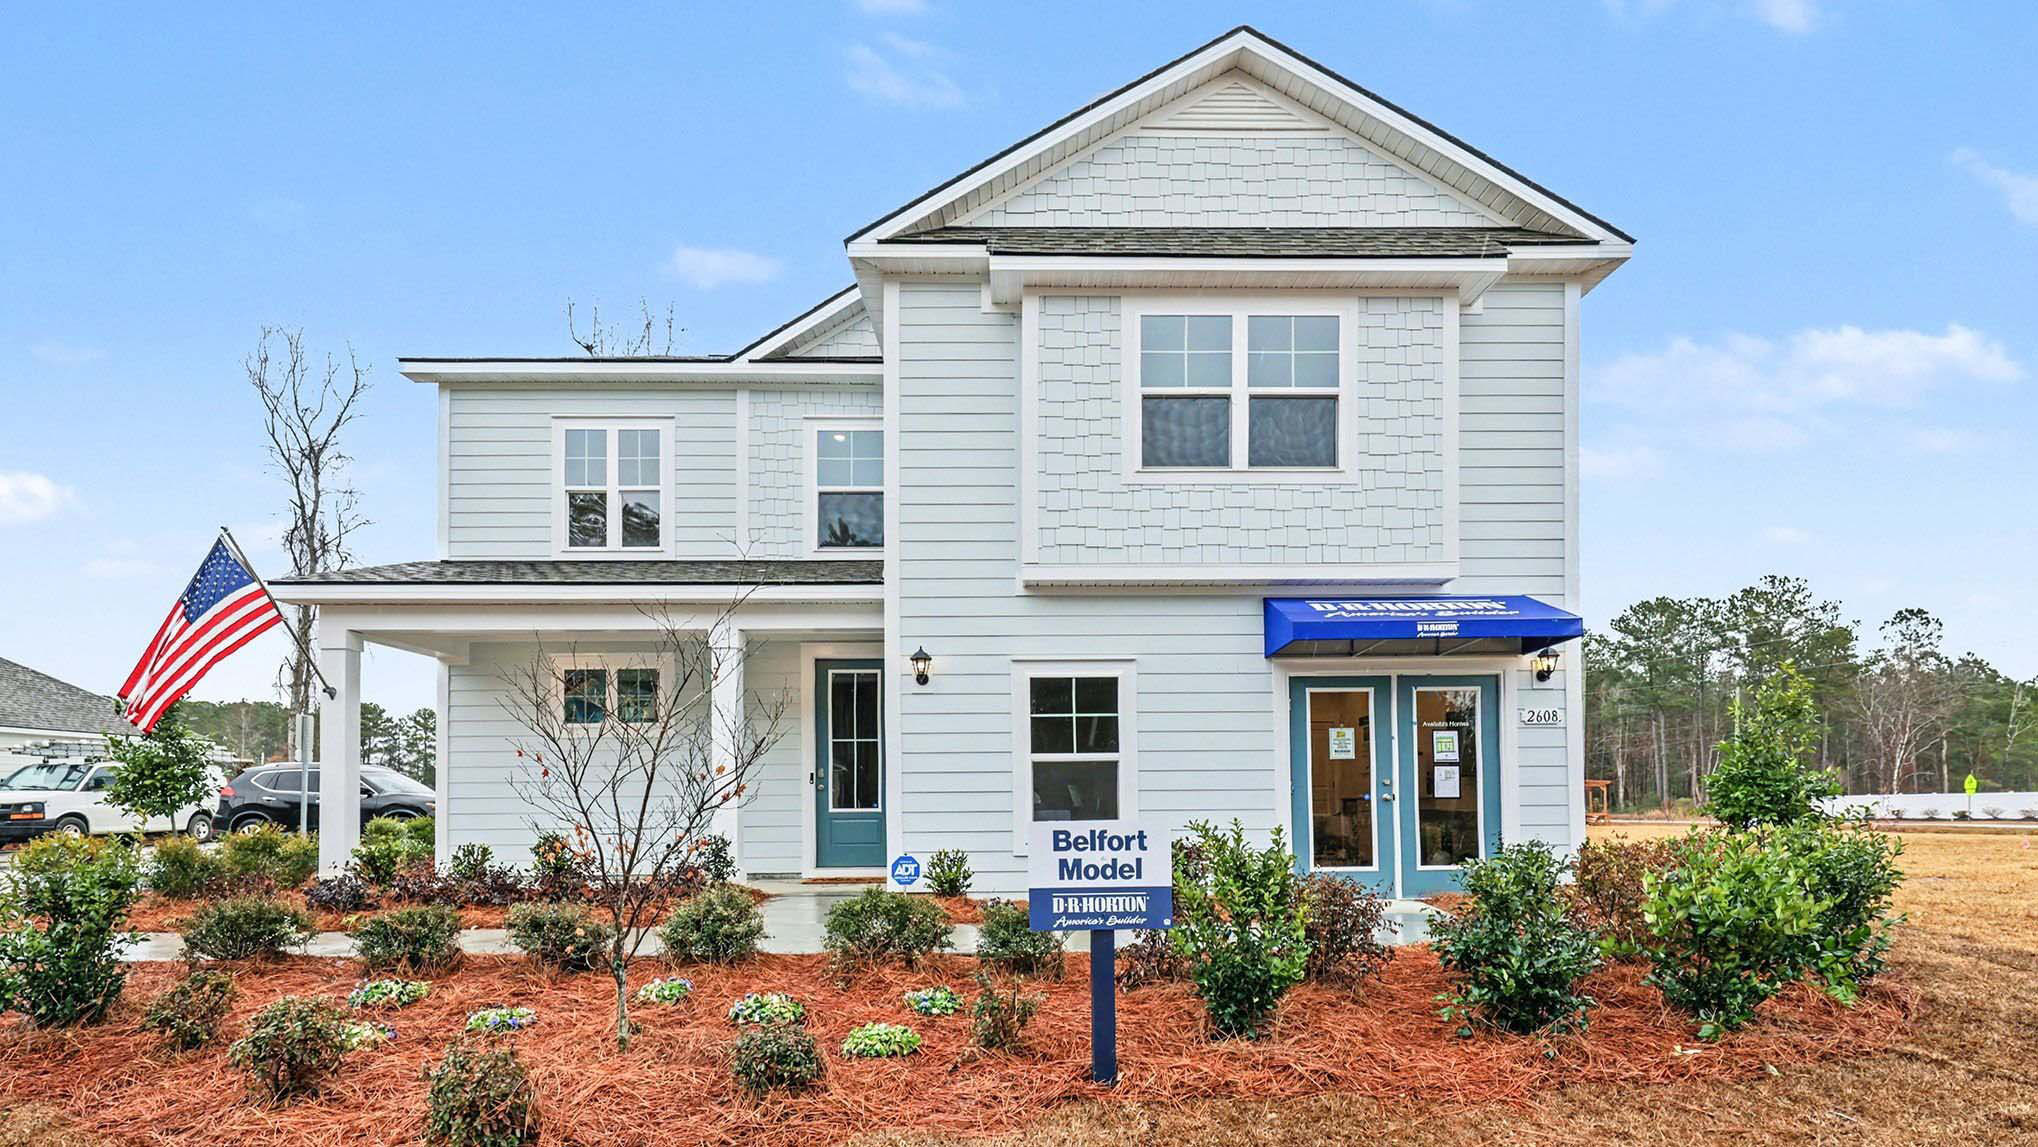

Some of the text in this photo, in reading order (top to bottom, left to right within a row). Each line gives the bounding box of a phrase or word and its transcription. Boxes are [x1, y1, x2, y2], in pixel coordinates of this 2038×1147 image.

[1435, 609, 1520, 617] Builder
[1527, 710, 1558, 722] 2608
[1422, 720, 1470, 728] Available Homes
[1053, 829, 1148, 852] Belfort
[894, 863, 918, 876] ADT
[1058, 857, 1143, 881] Model
[1053, 914, 1148, 928] America's Builder
